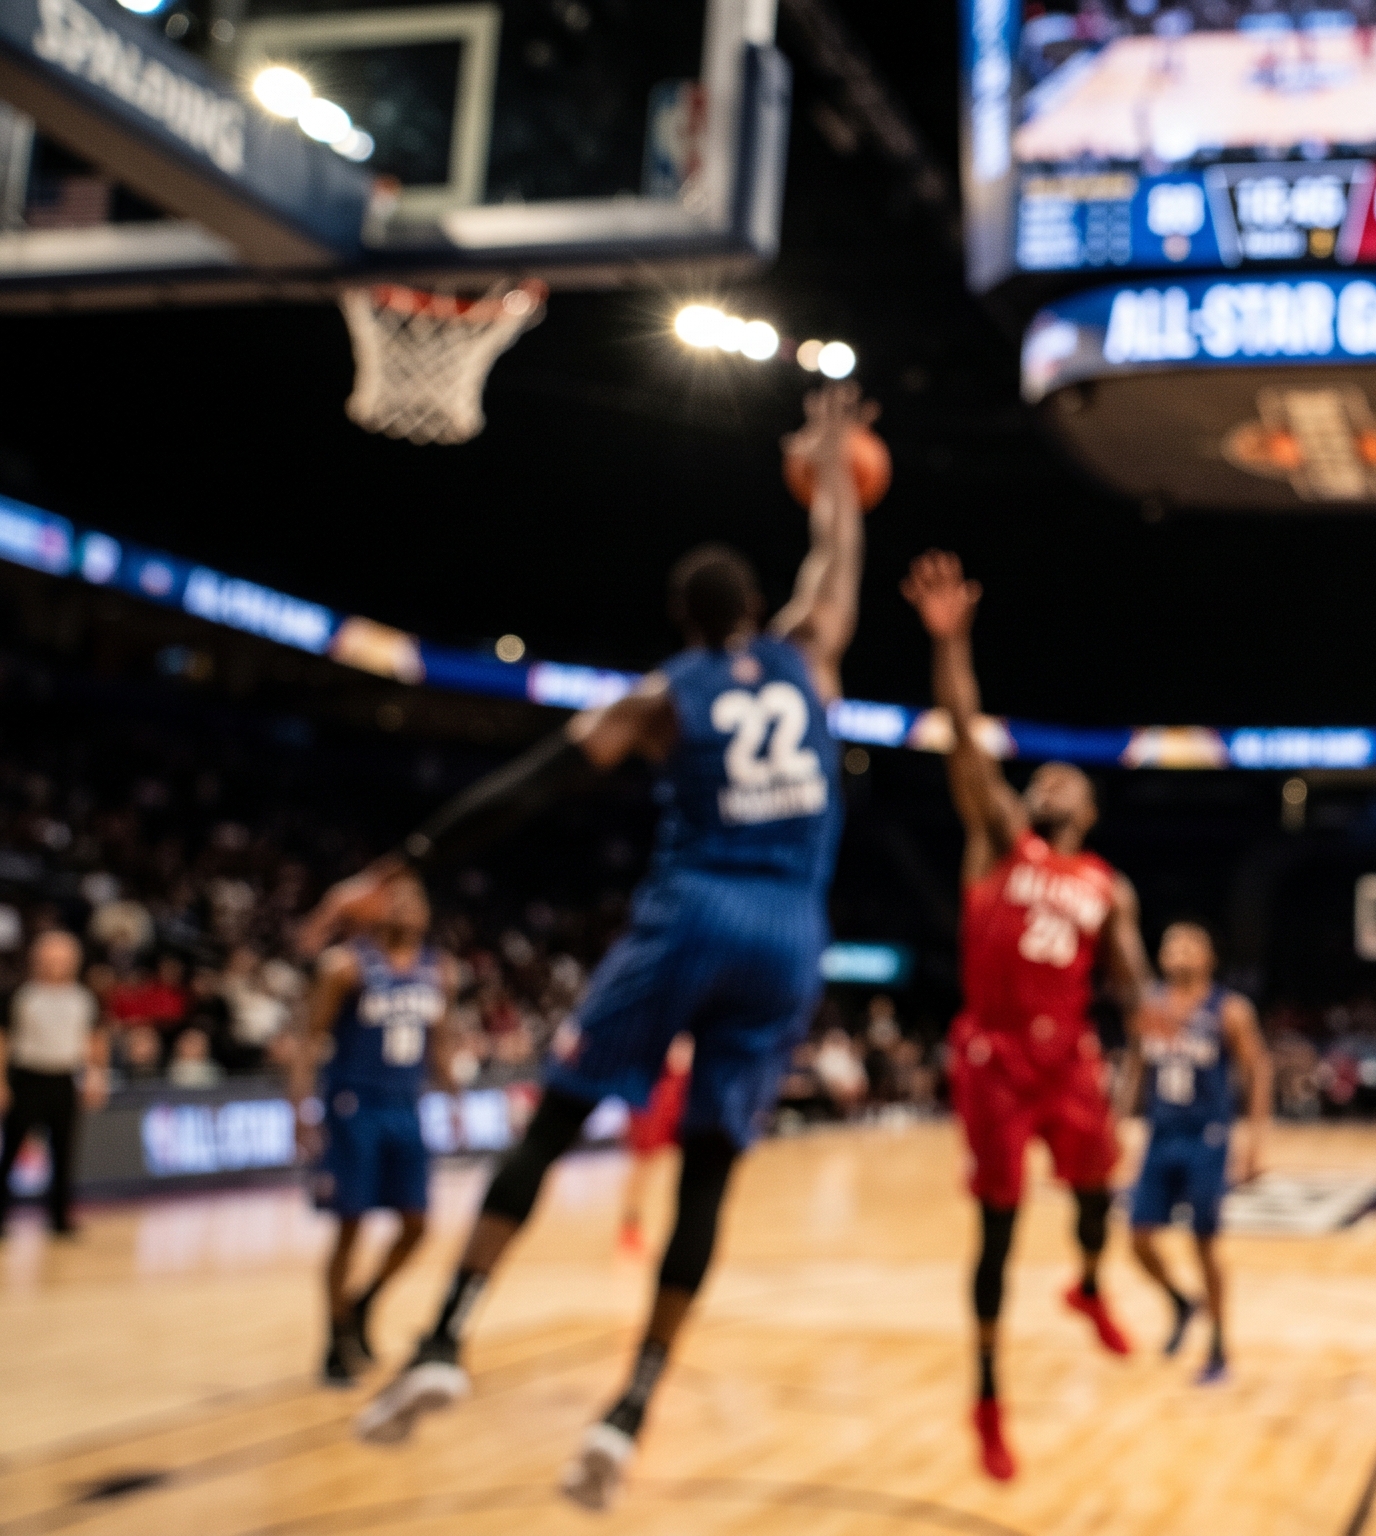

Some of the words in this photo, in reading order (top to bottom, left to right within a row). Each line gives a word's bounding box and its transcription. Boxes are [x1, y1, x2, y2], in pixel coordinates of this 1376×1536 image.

[34, 0, 245, 176] SPALDING
[1104, 283, 1335, 362] ALL-STAR
[711, 681, 820, 786] 22
